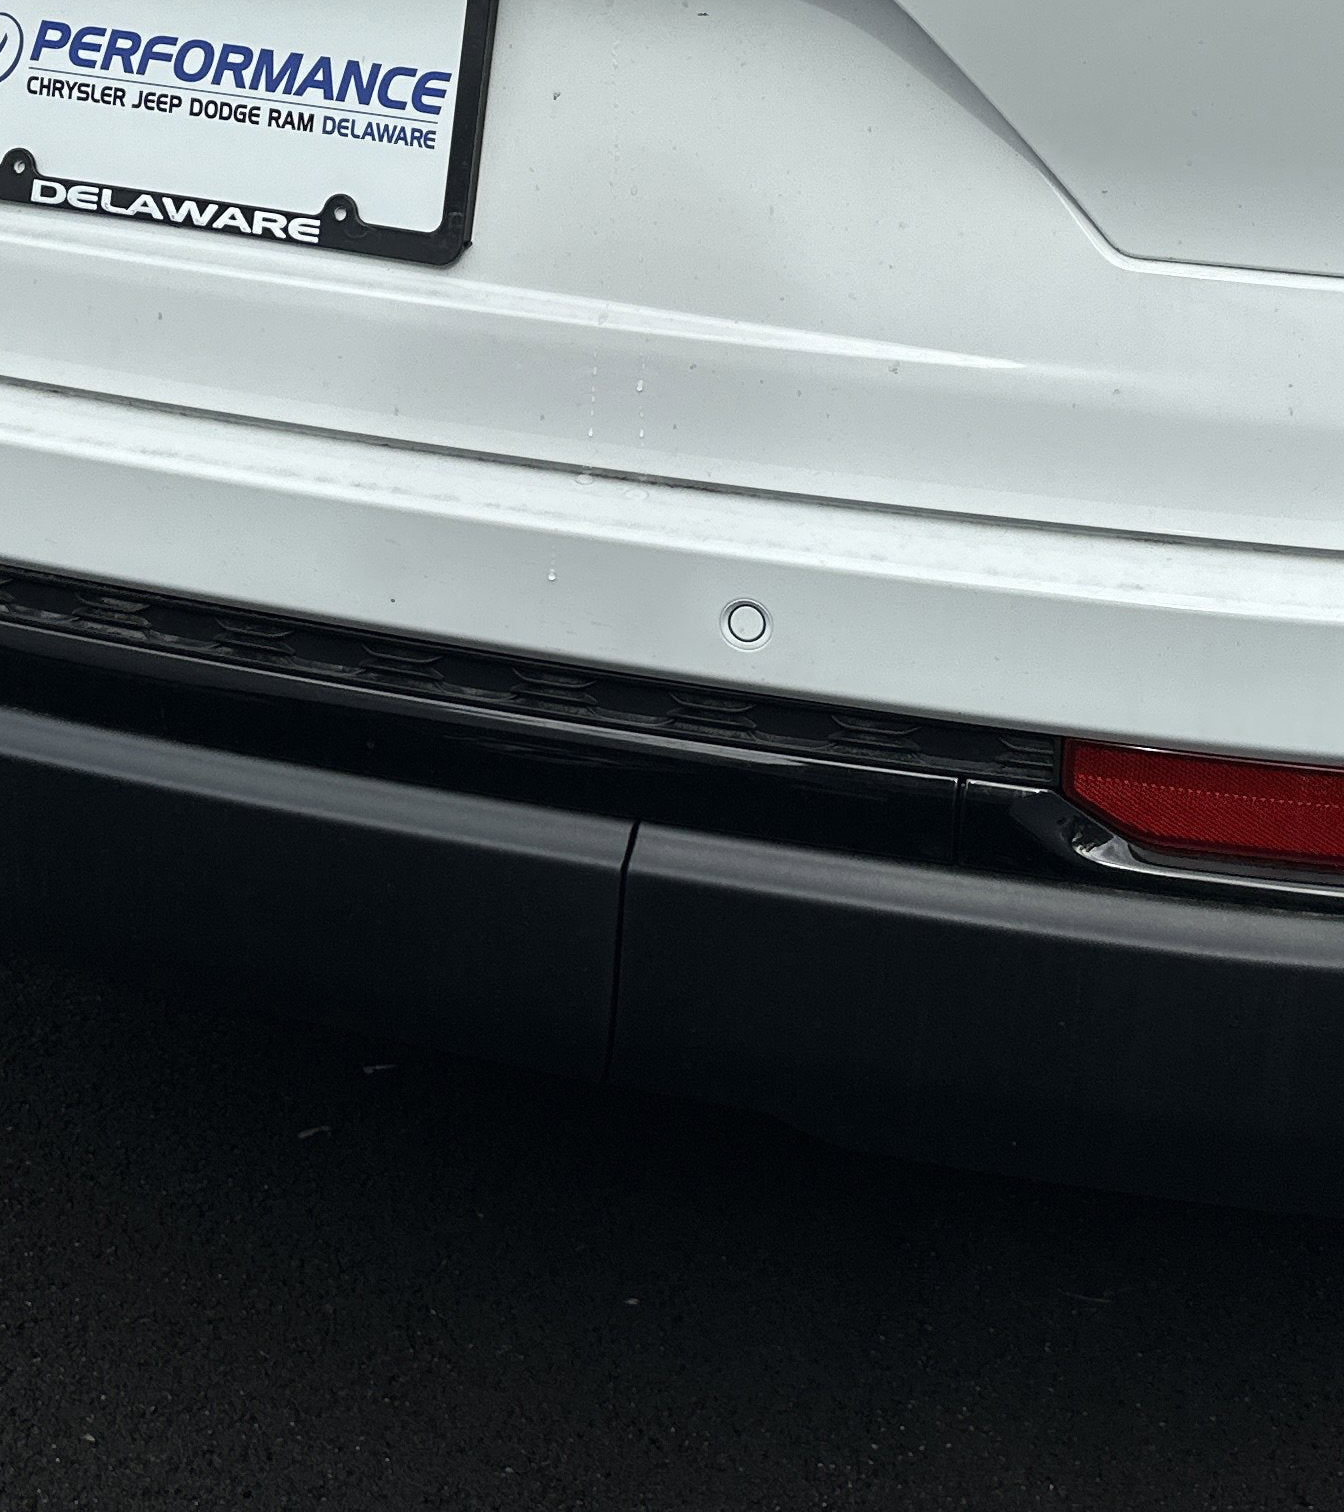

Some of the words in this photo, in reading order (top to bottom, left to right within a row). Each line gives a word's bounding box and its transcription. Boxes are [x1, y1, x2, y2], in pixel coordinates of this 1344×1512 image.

[30, 19, 452, 116] PERFORMANCE
[27, 76, 126, 107] CHRYSLER
[131, 90, 183, 114] JEEP
[189, 97, 261, 125] DODGE
[268, 108, 315, 133] RAM
[322, 115, 437, 150] DELAWARE
[30, 179, 321, 245] DELAWARE
